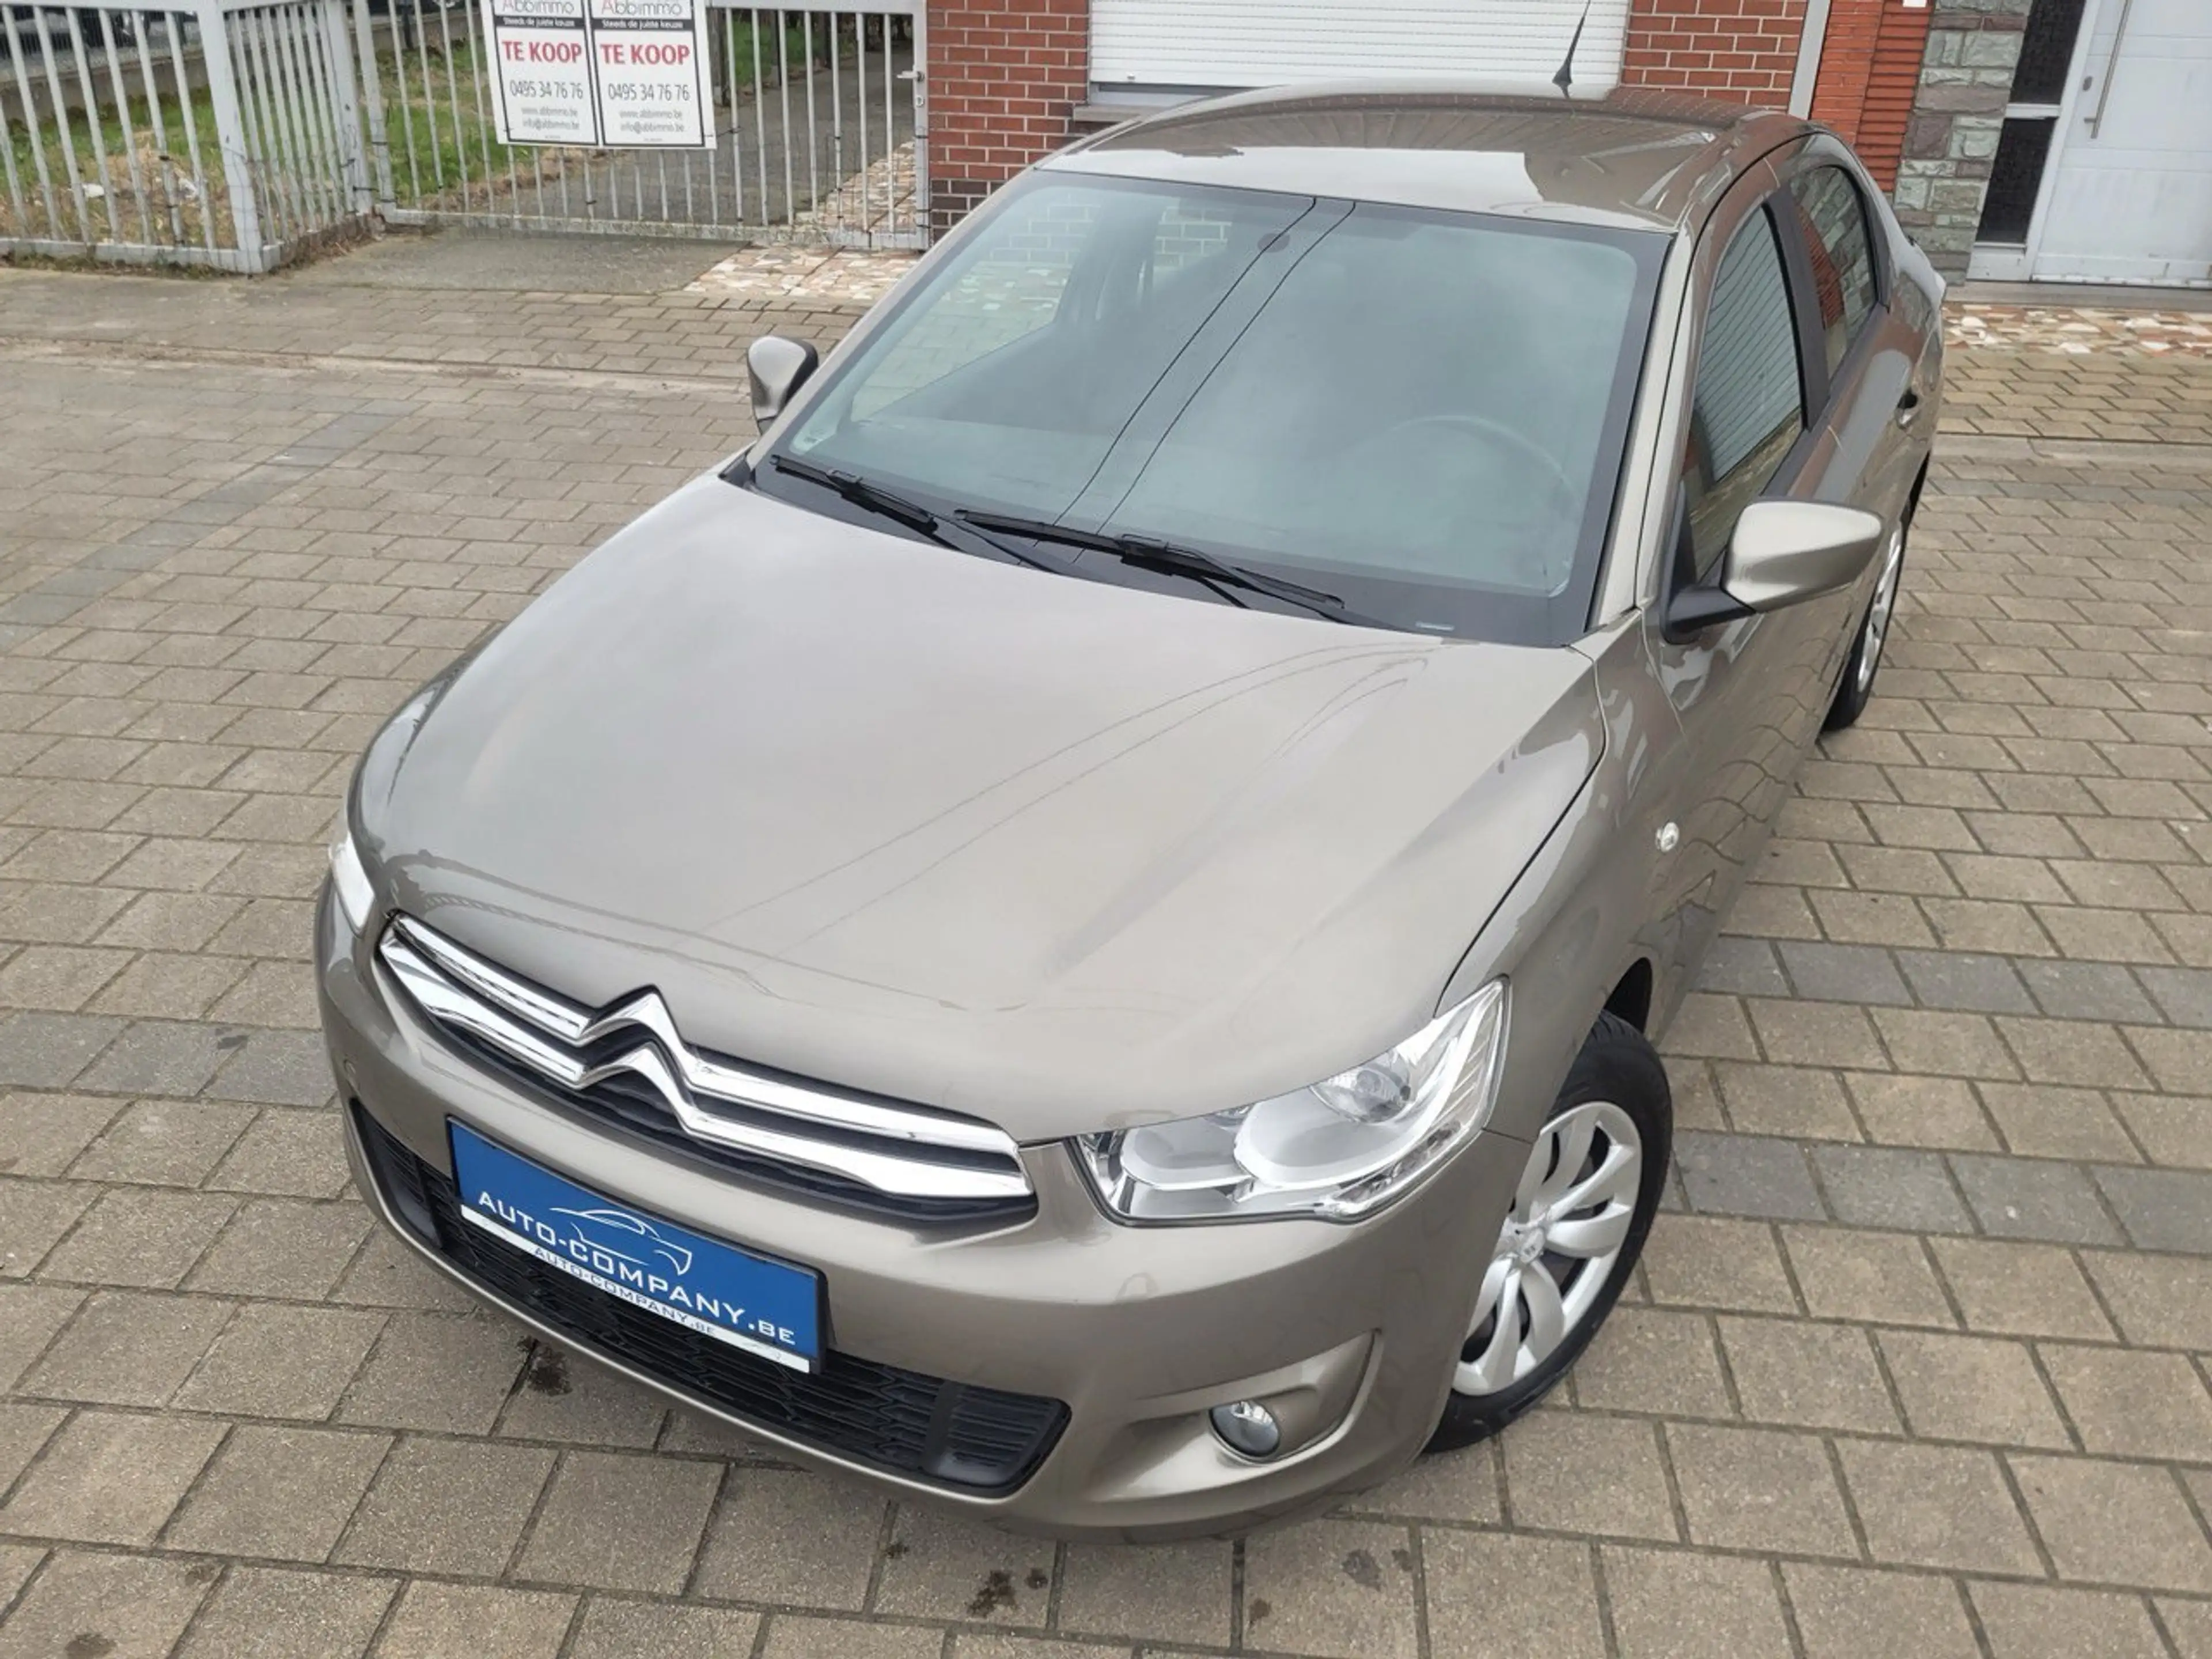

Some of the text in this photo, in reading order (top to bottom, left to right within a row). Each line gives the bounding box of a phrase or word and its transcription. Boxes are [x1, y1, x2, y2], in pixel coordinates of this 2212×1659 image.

[627, 20, 638, 28] de
[502, 40, 582, 63] TE KOOP
[600, 44, 690, 65] TE KOOP
[510, 79, 583, 100] 0495 34 76 76
[608, 82, 690, 101] 0495 34 76 76
